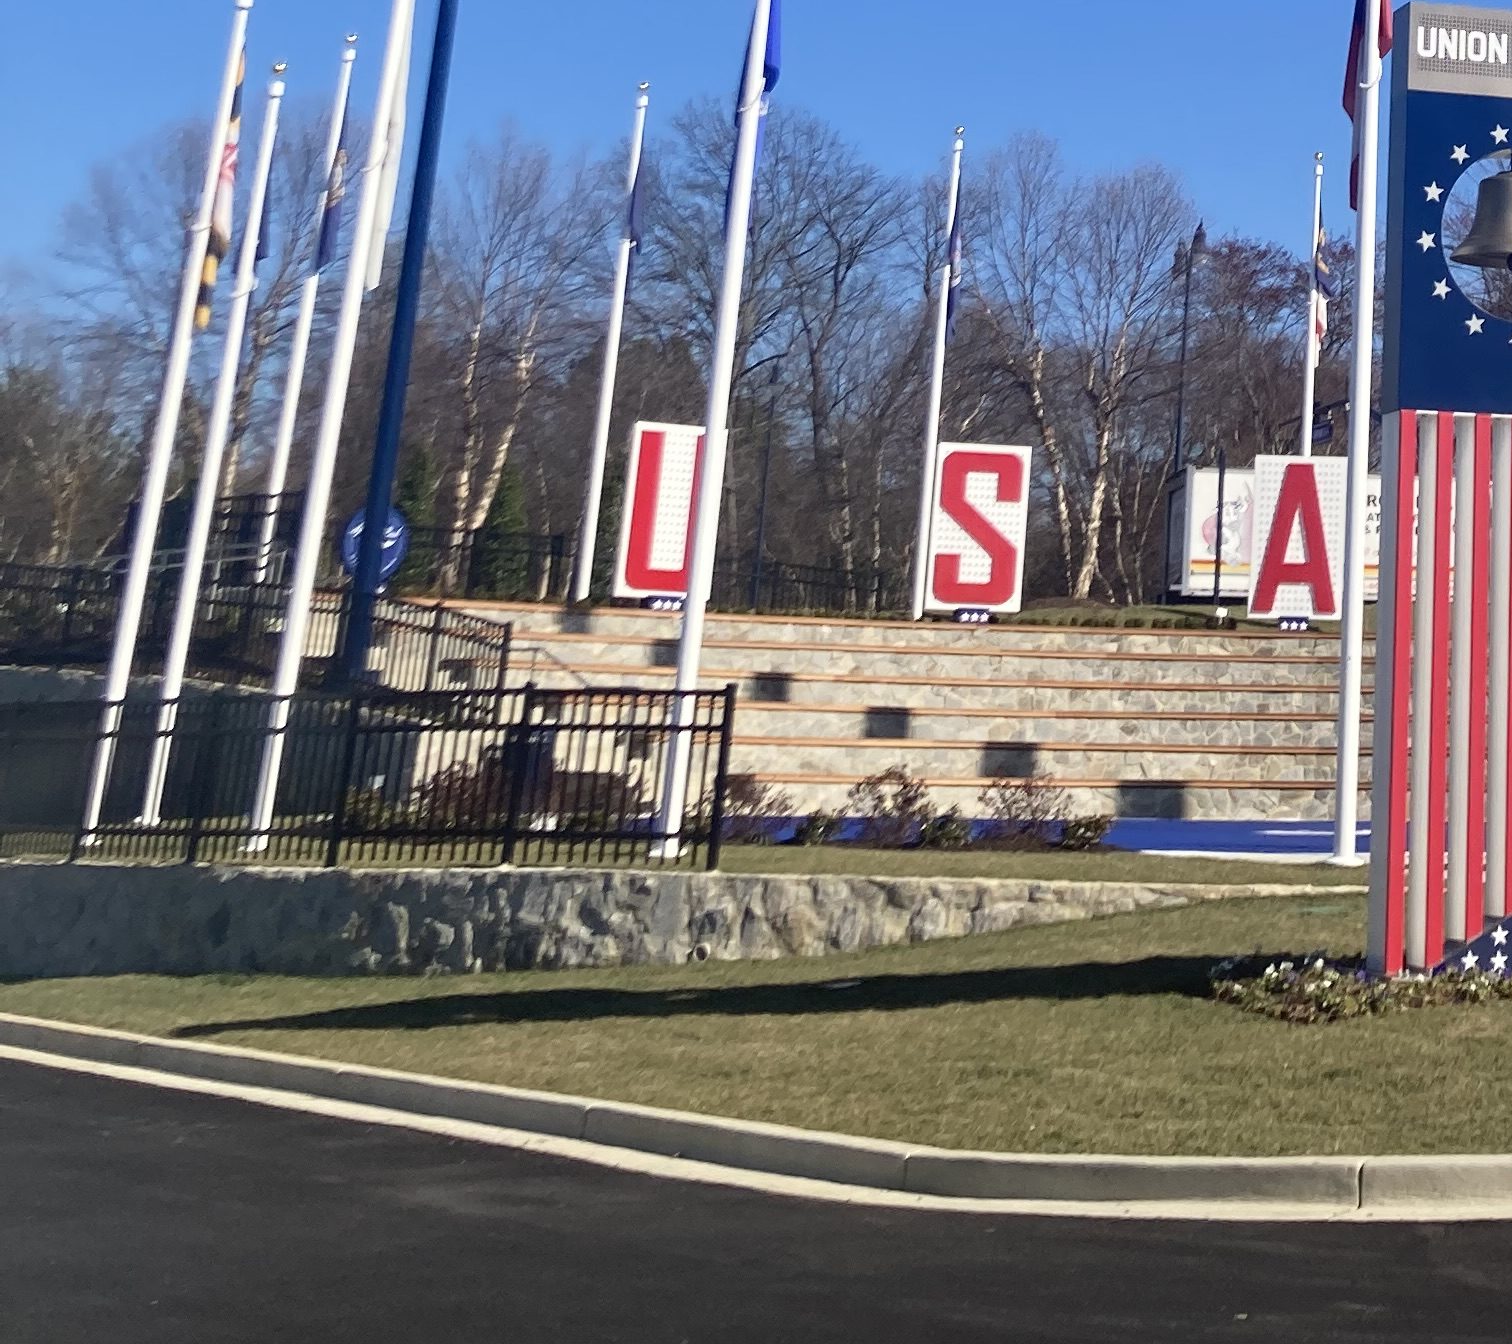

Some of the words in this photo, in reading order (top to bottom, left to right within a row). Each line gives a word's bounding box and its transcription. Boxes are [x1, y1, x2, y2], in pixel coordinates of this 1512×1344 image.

[1416, 25, 1509, 65] UNION
[625, 430, 704, 593] U
[932, 451, 1023, 605] S
[1250, 463, 1335, 615] A
